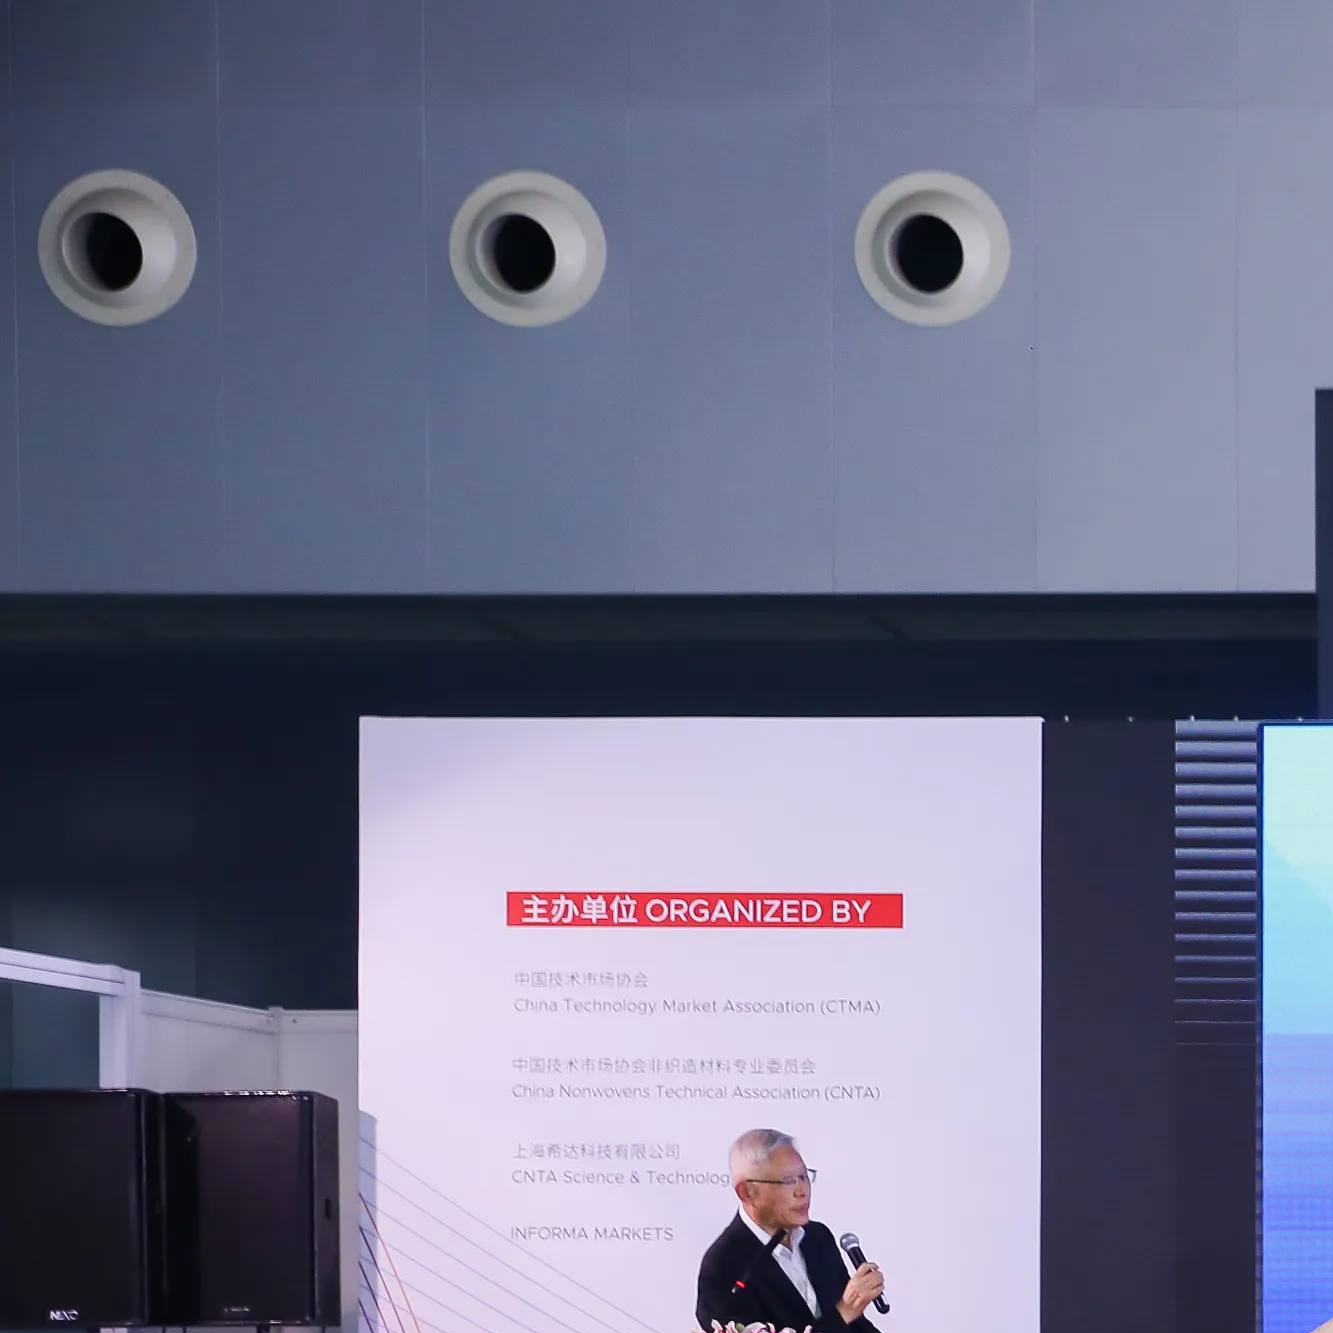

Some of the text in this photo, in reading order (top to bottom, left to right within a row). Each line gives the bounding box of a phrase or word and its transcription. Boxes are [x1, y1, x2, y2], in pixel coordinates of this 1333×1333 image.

[521, 895, 871, 924] 主办单位 ORGANIZED BY
[513, 971, 649, 989] 中国技术市场协会
[513, 999, 881, 1016] China Technology Market Association (CTMA)
[512, 1057, 816, 1075] 中国技术市场协会非织造材料专业委员会
[511, 1084, 881, 1101] China Nonwovens Technical Association (CNTA)
[512, 1143, 681, 1160] 上海希达科技有限公司
[511, 1170, 731, 1187] CNTA Science & Technolog
[510, 1226, 674, 1241] INFORMA MARKETS
